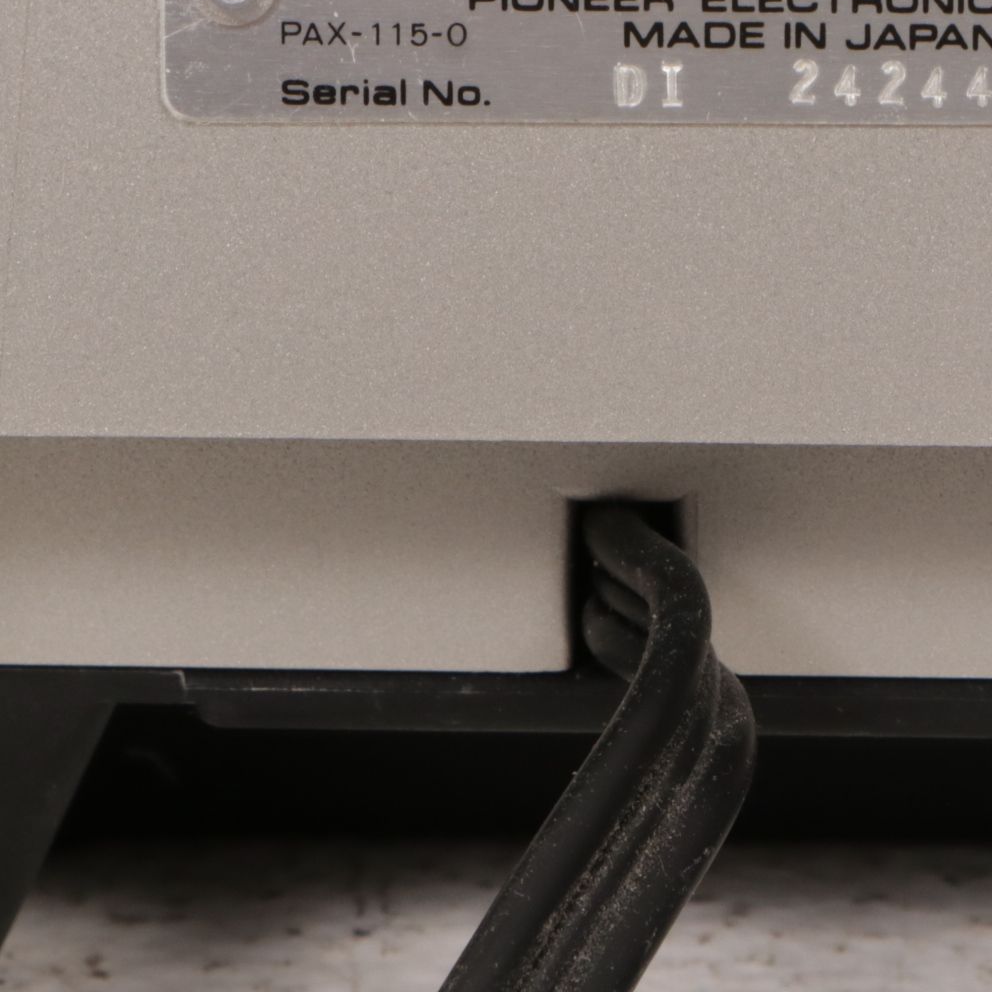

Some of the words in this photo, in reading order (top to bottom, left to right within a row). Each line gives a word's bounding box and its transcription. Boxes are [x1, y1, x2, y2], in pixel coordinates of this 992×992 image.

[281, 21, 467, 47] PAX-115-0
[624, 21, 765, 49] MADE
[784, 22, 826, 49] IN
[281, 79, 406, 106] Serial
[423, 80, 491, 106] No.
